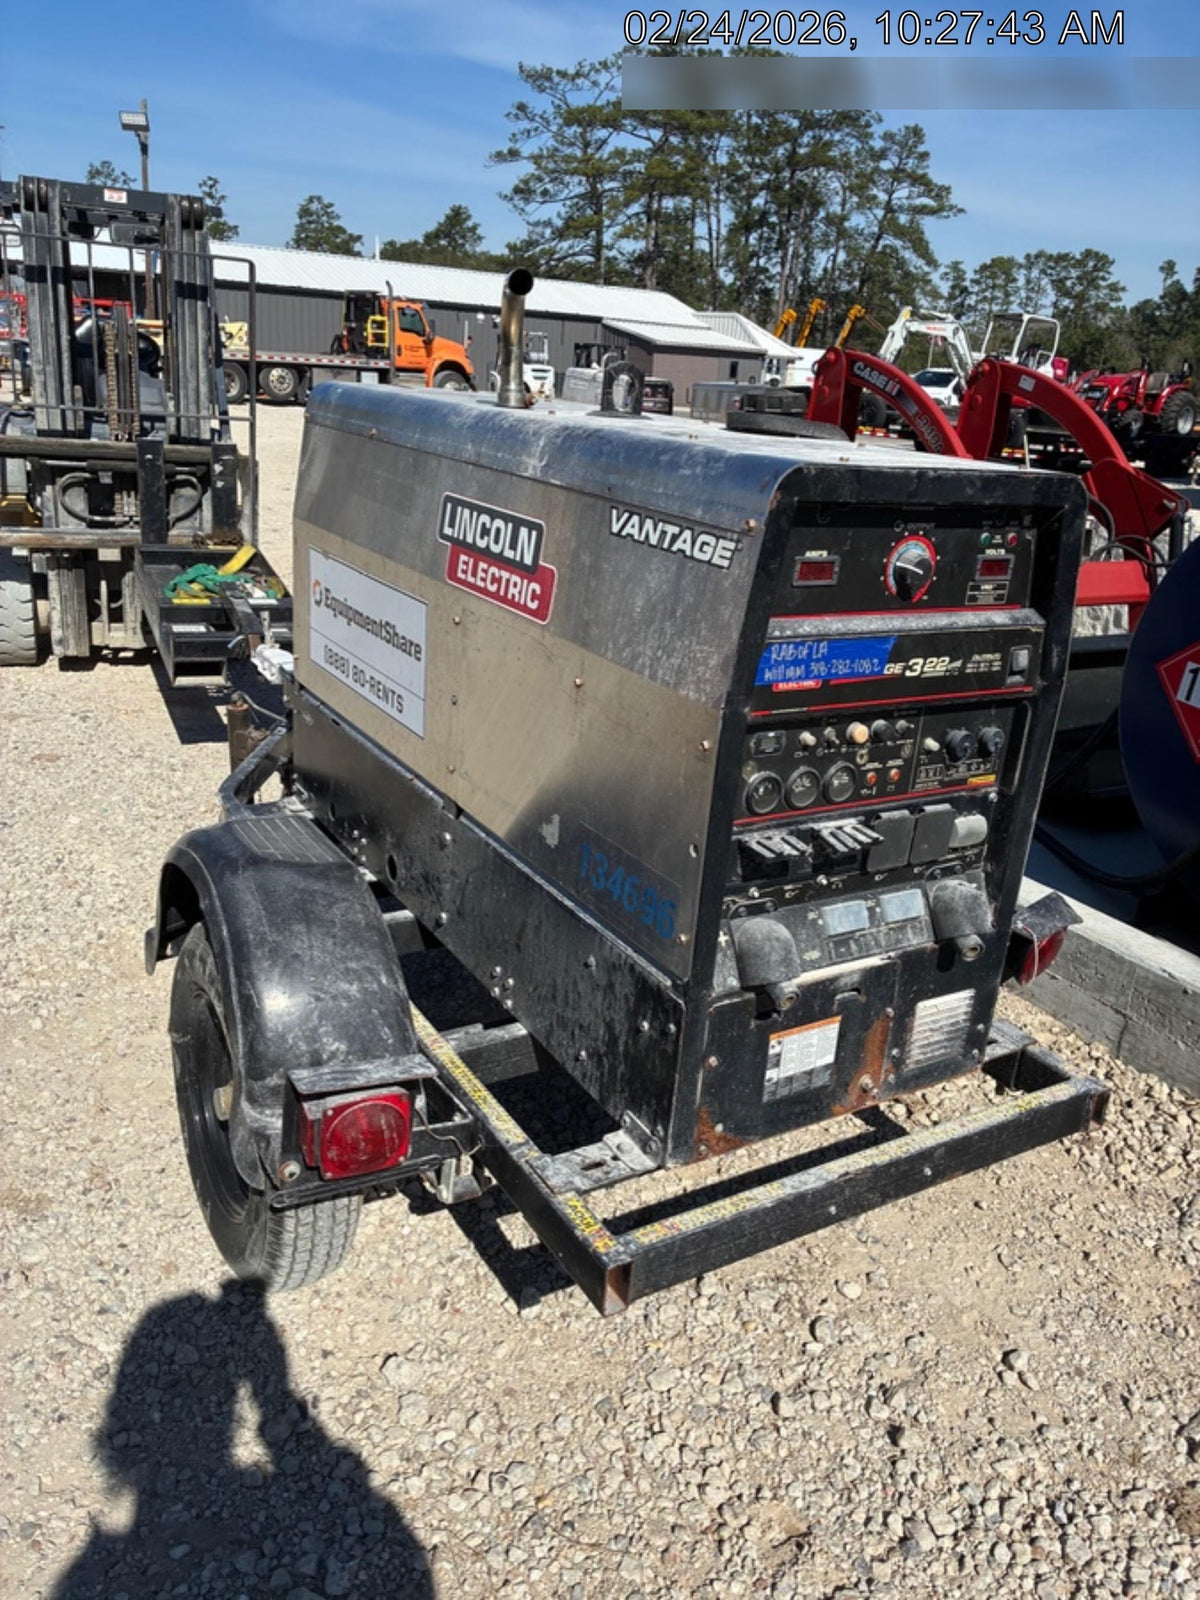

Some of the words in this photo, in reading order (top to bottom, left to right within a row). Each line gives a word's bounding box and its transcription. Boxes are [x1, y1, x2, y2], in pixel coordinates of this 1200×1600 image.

[853, 361, 888, 389] CASE
[443, 502, 537, 567] LINCOLN
[610, 507, 738, 569] VANTAGE
[456, 553, 541, 611] ELECTRIC
[323, 585, 422, 663] EquipmentShare
[323, 643, 350, 679] (888)
[351, 663, 405, 715] 80-RENTS
